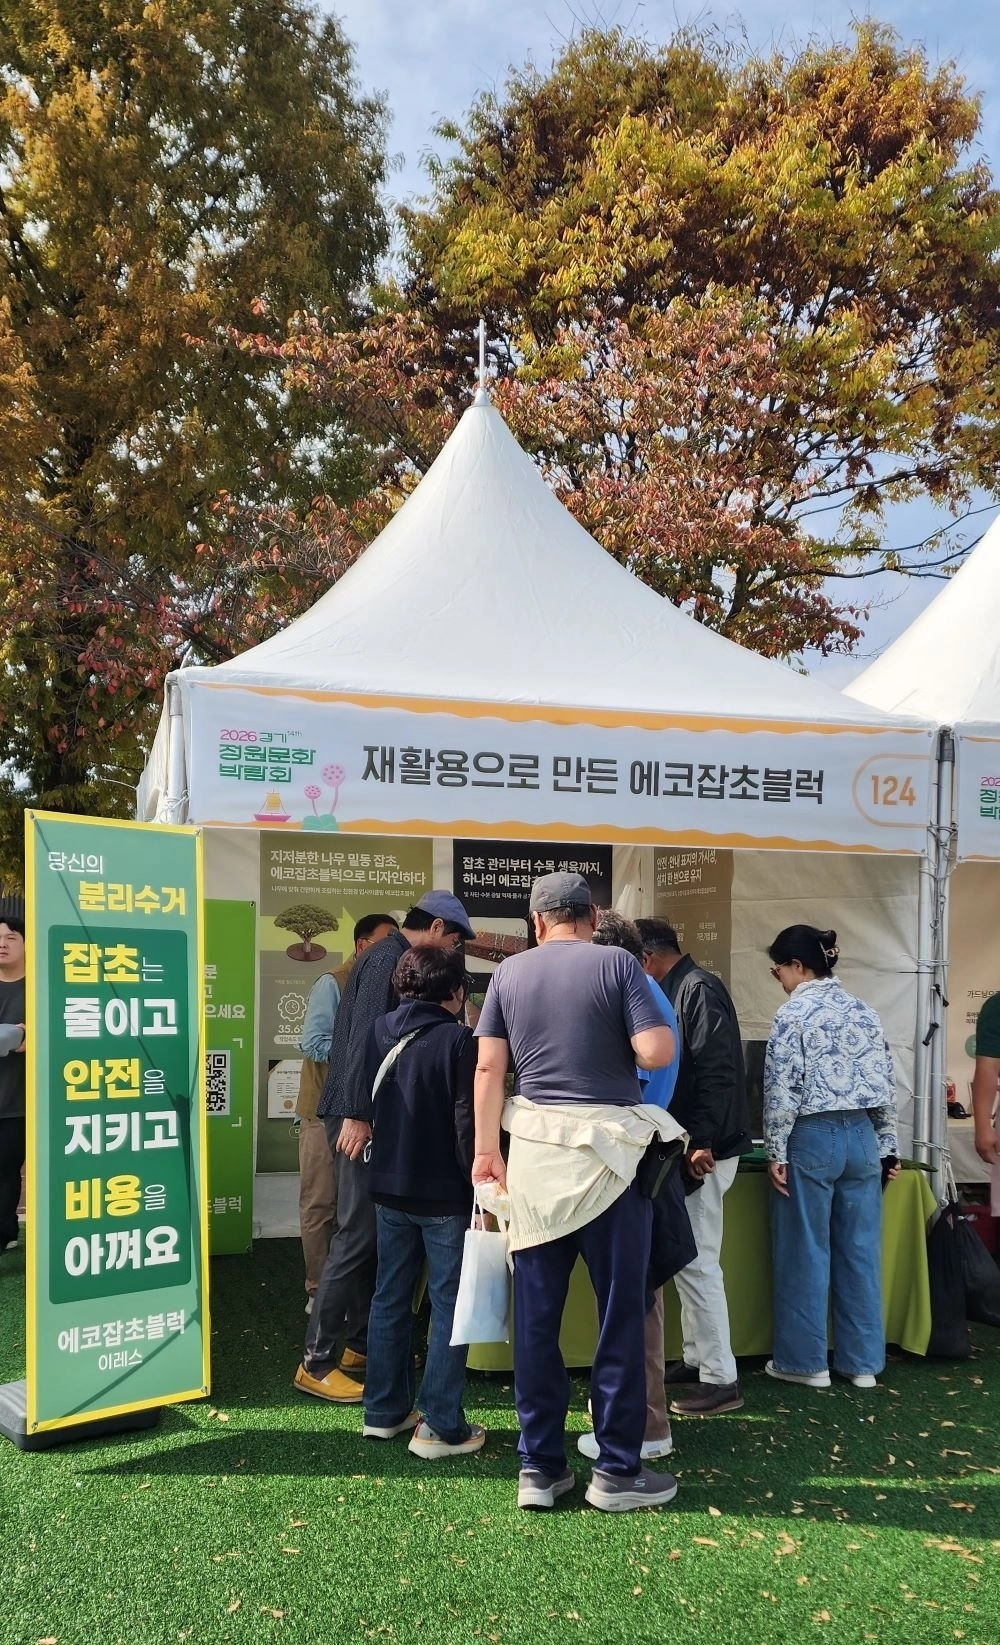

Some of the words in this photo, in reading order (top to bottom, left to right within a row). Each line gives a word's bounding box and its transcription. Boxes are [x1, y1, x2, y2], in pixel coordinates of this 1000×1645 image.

[220, 729, 257, 742] 2026
[259, 732, 287, 743] 경기
[219, 744, 316, 765] 정원문화
[219, 763, 292, 783] 박람회
[361, 744, 540, 790] 재활용으로
[553, 756, 619, 795] 만든
[630, 759, 824, 805] 에코잡초블럭
[981, 777, 1000, 787] 202
[871, 775, 916, 807] 124
[48, 851, 104, 874] 당신의
[270, 849, 319, 865] 지저분한
[321, 852, 345, 866] 나무
[373, 854, 400, 870] 잡초,
[462, 856, 486, 870] 잡초
[487, 858, 531, 873] 관리부터
[533, 859, 556, 873] 수목
[557, 860, 604, 877] 생육까지,
[270, 866, 366, 883] 에코잡초블럭으로
[368, 870, 426, 886] 디자인하다
[463, 872, 496, 887] 하나의
[78, 880, 186, 916] 분리수거
[63, 943, 164, 983] 잡초는
[63, 997, 178, 1038] 줄이고
[205, 1003, 246, 1019] 으세요
[63, 1058, 166, 1100] 안전을
[64, 1110, 179, 1155] 지키고
[65, 1174, 167, 1220] 비용을
[208, 1195, 242, 1215] 블럭
[64, 1225, 180, 1276] 아껴요
[57, 1308, 186, 1354] 에코잡초블럭
[98, 1348, 143, 1371] 이레스
